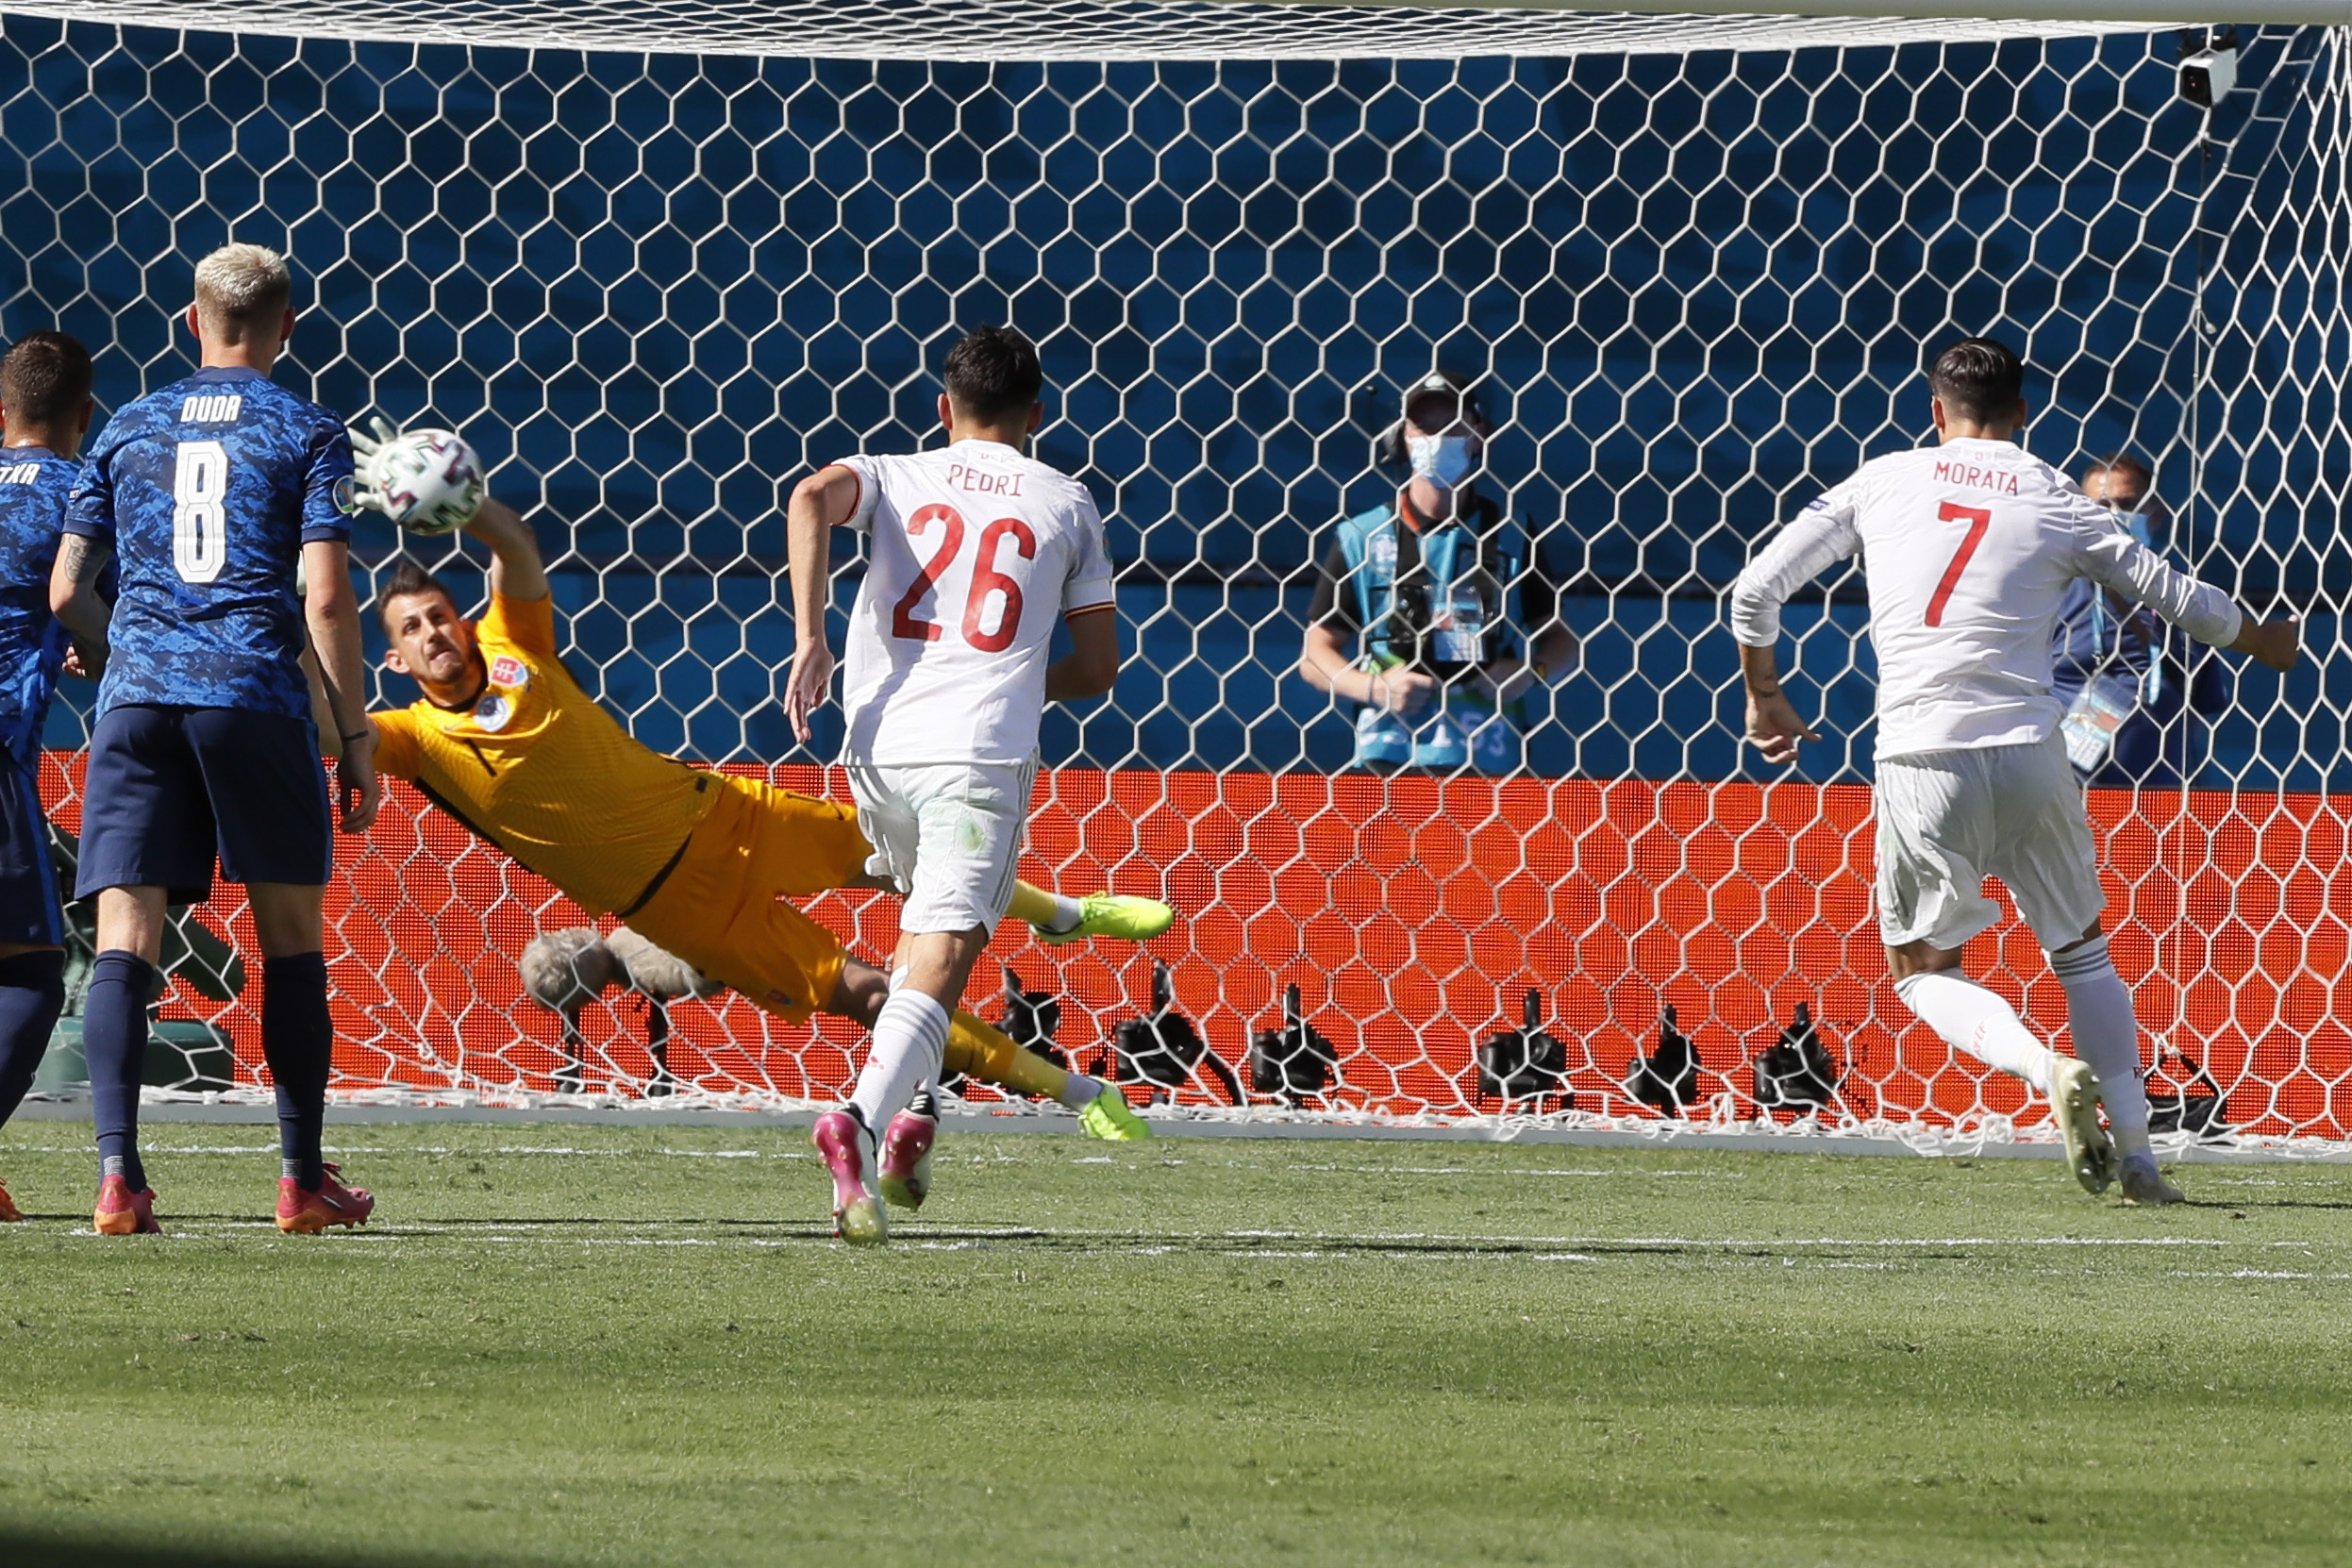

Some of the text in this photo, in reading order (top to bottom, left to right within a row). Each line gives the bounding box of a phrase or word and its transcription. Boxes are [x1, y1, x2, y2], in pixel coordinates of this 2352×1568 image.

[180, 395, 242, 422] DUDA
[173, 441, 228, 583] 8
[948, 464, 1025, 497] PEDRI
[1933, 460, 2018, 496] MORATA
[892, 503, 1037, 653] 26
[1925, 501, 1992, 627] 7
